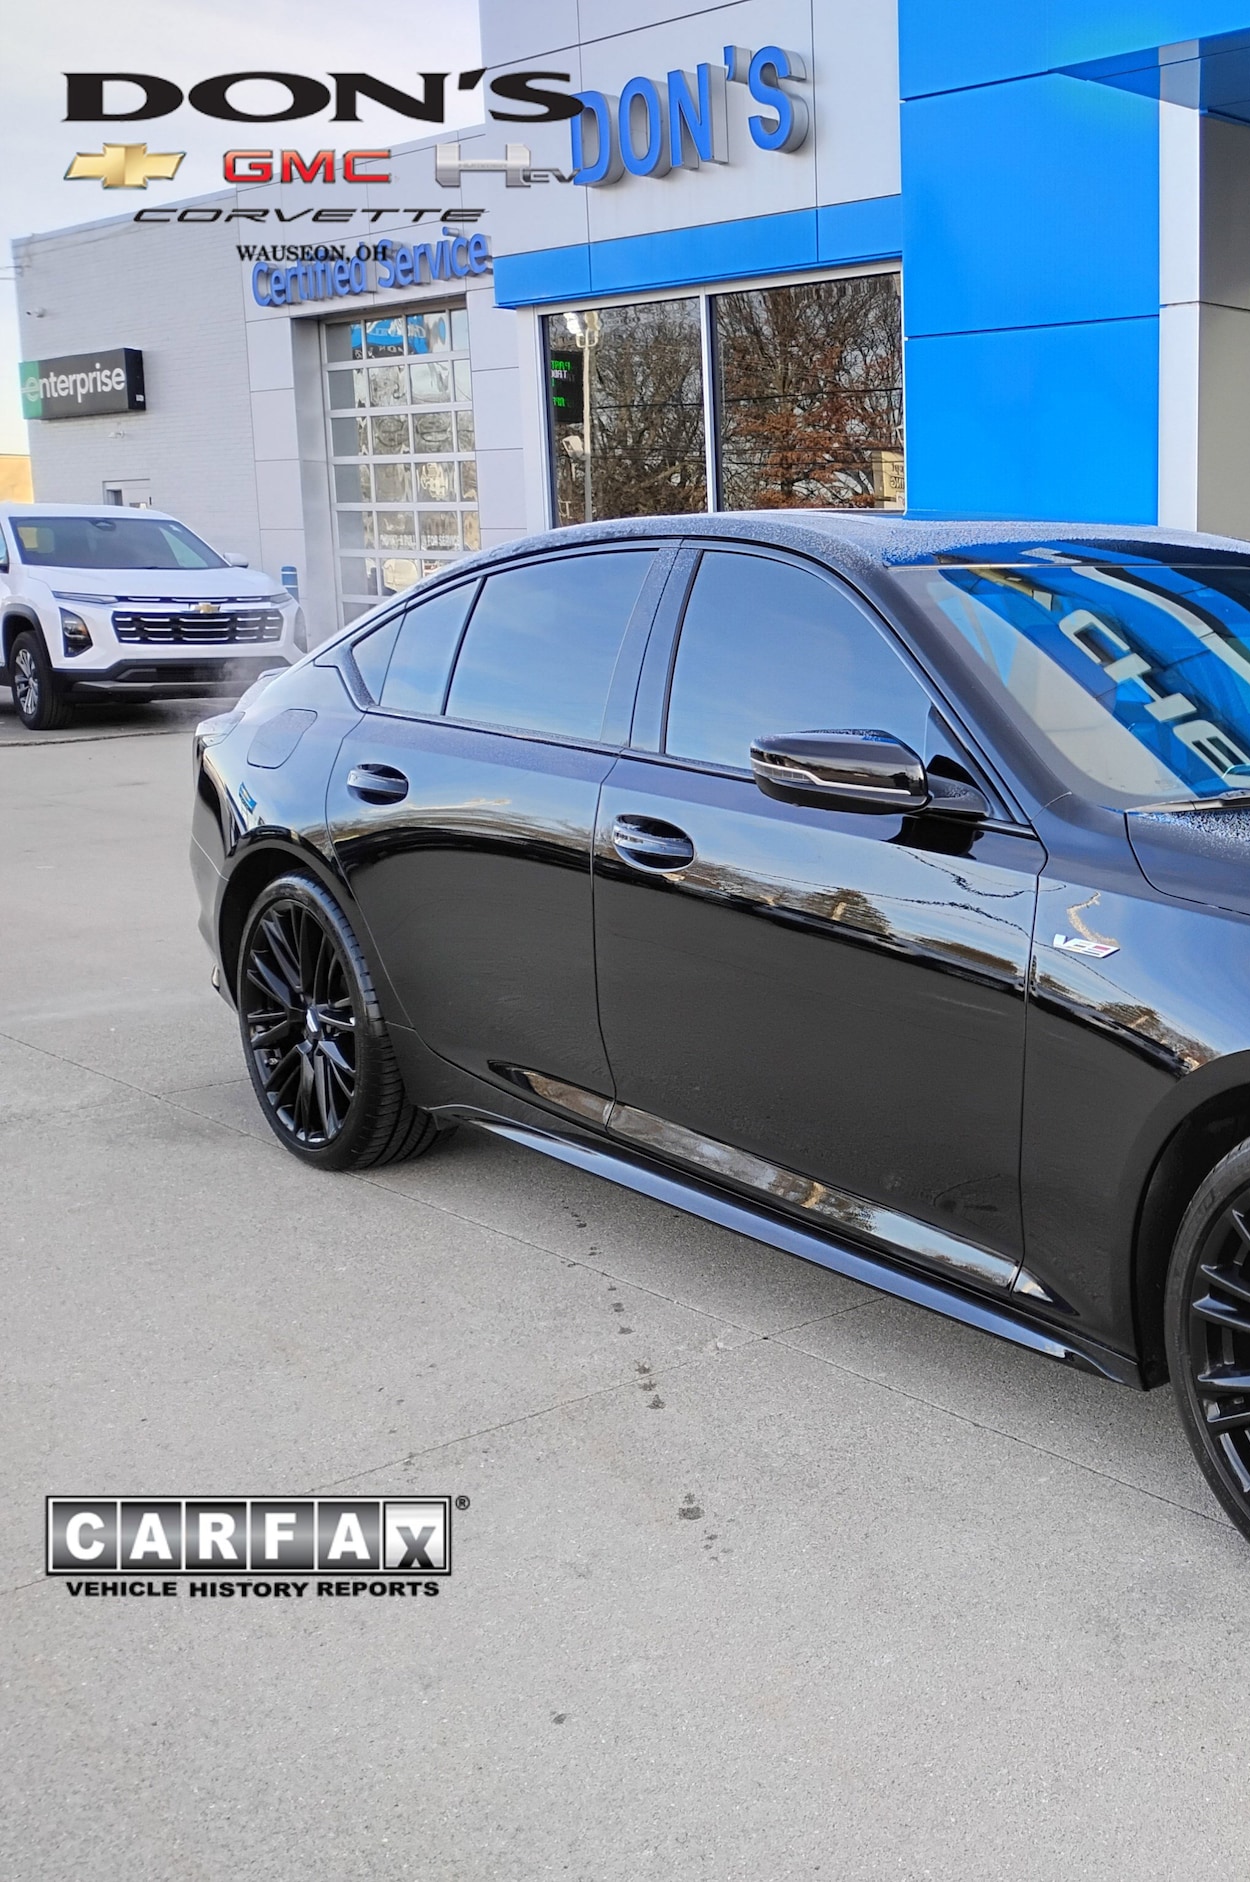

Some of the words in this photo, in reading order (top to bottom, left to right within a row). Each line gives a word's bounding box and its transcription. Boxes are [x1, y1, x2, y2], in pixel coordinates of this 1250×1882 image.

[570, 44, 802, 186] DON'S
[252, 241, 368, 307] Certified
[378, 226, 490, 289] Service
[21, 362, 126, 403] enterprise
